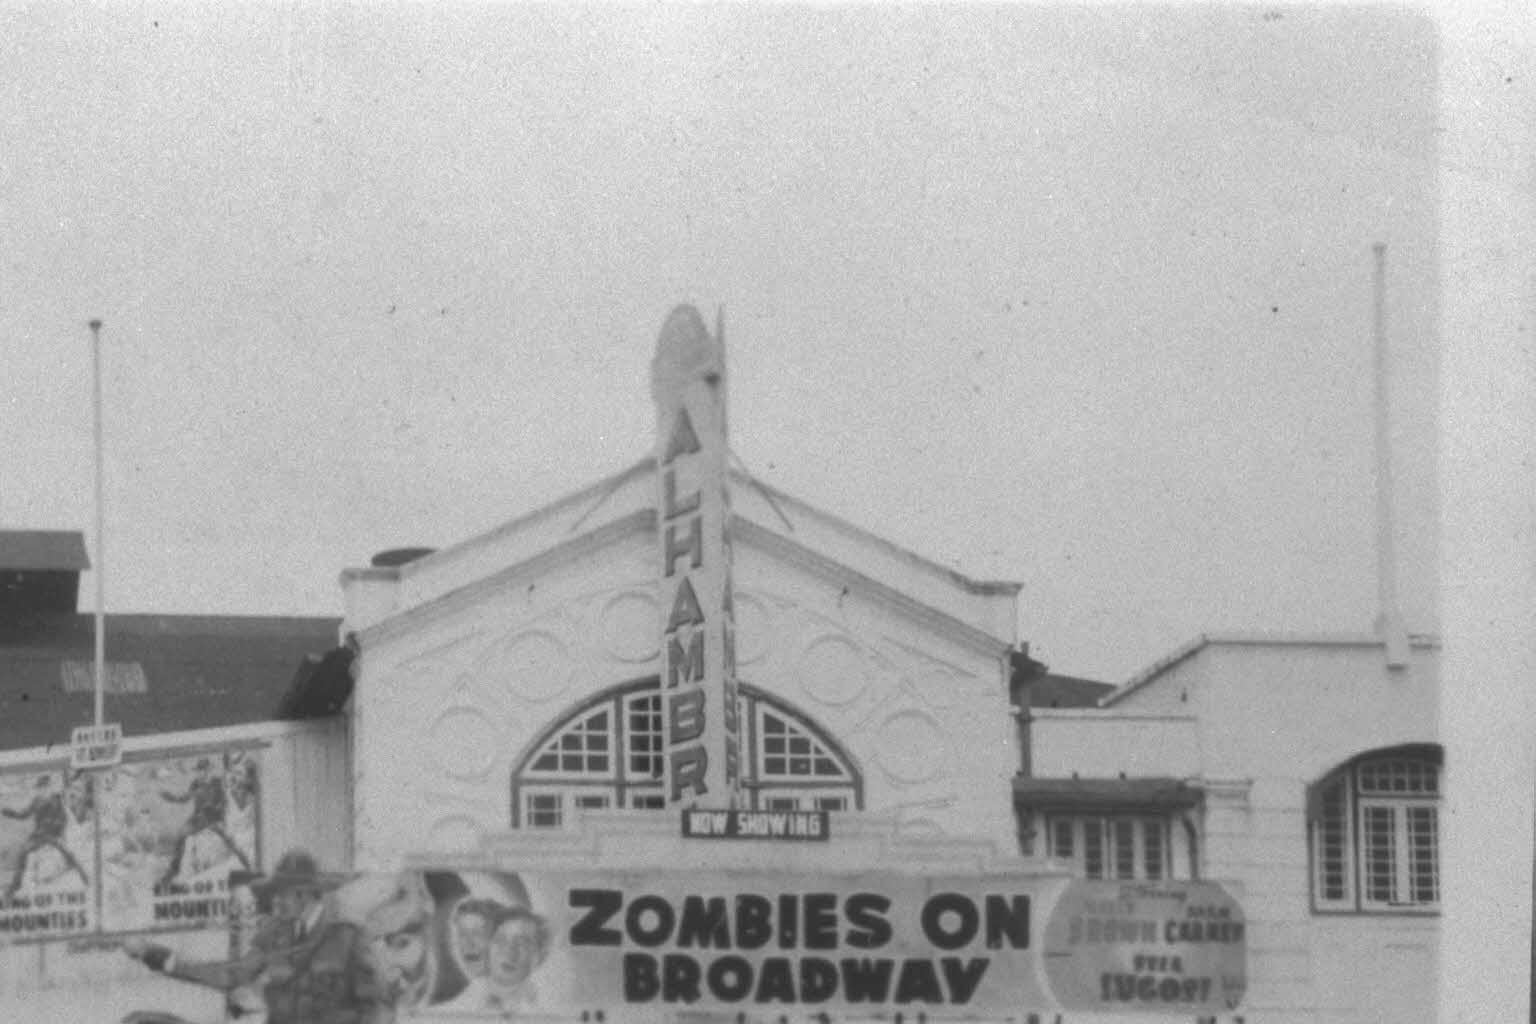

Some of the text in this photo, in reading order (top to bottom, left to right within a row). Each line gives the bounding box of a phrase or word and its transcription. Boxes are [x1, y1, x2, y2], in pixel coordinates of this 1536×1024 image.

[662, 406, 709, 808] ALHAMBR
[690, 812, 822, 835] NOW SHOWING
[568, 888, 1031, 950] ZOMBIES ON
[622, 952, 991, 1005] BROADWAY
